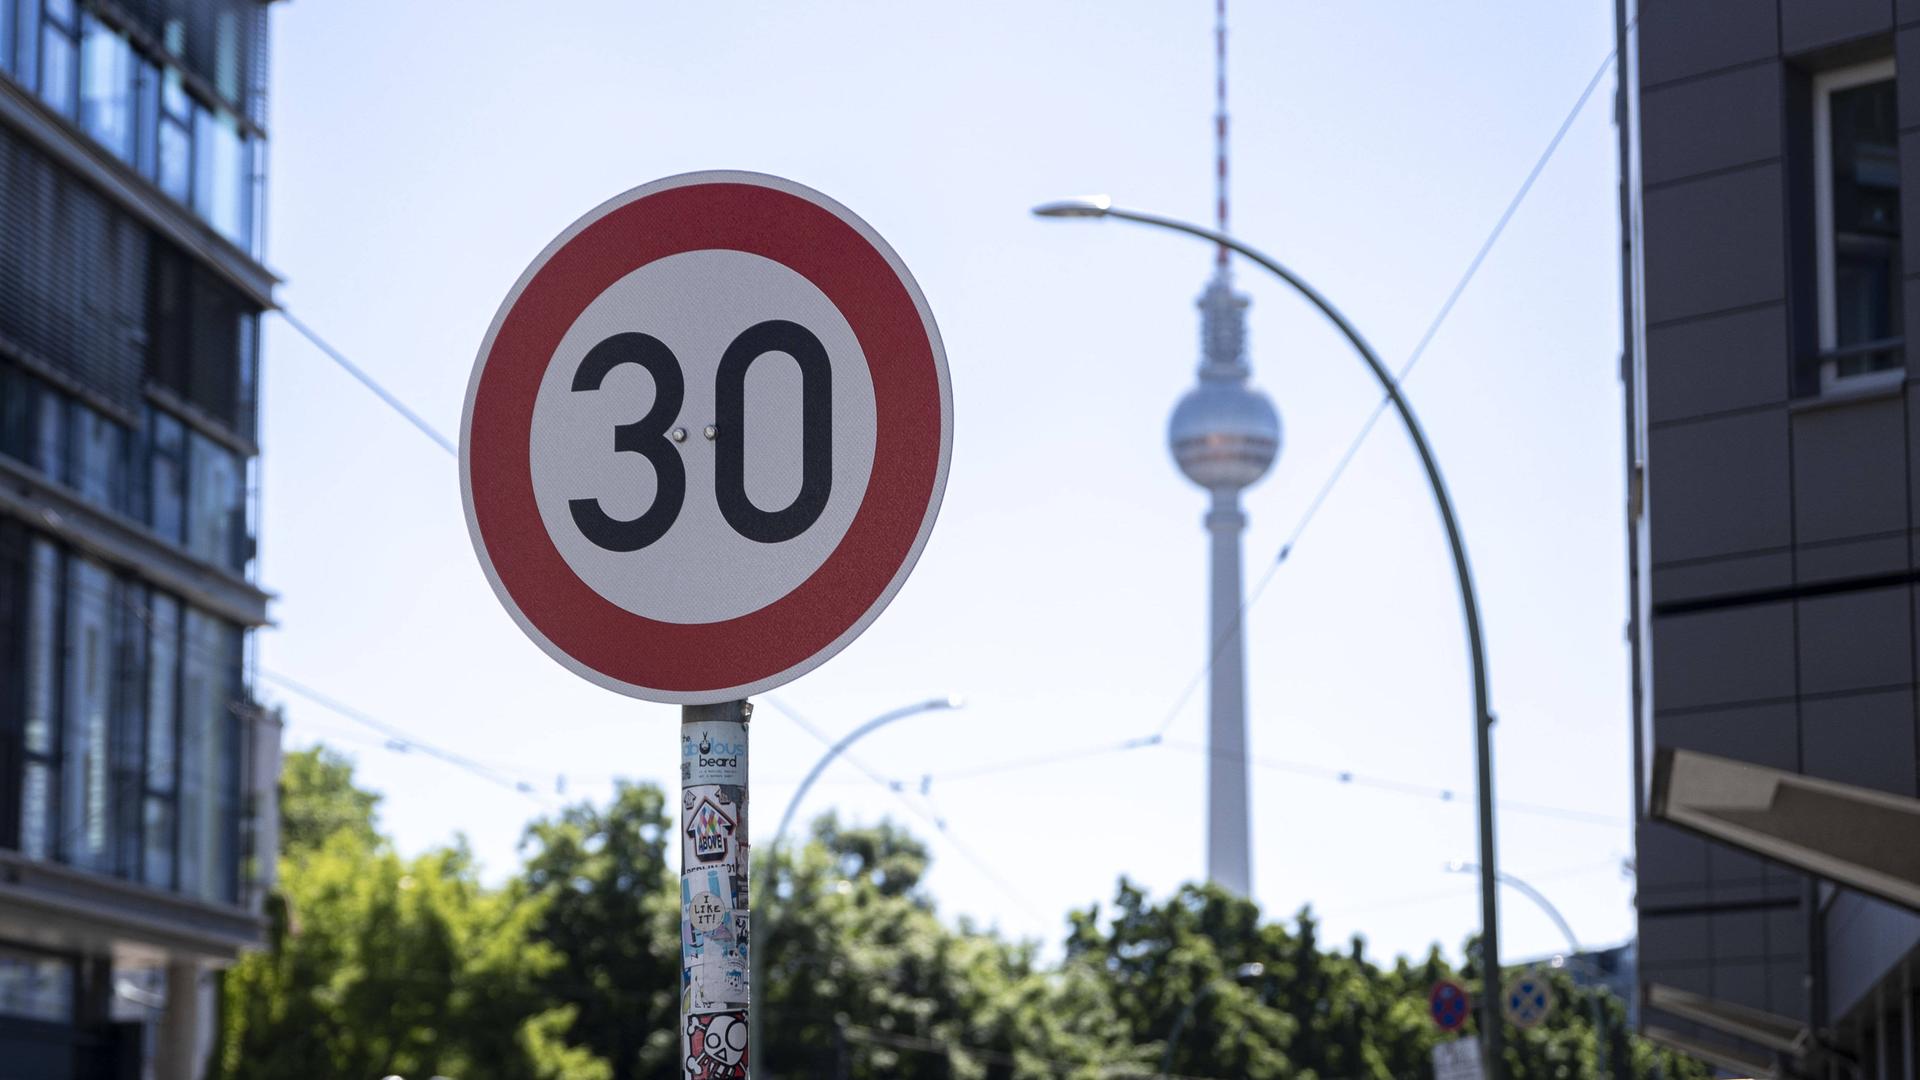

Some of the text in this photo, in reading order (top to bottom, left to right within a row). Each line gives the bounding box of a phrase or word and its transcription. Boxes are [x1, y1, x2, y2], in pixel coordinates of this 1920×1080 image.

[568, 319, 832, 552] 30
[683, 736, 744, 757] abulous
[699, 754, 737, 768] beard
[698, 834, 723, 852] ABOVE
[704, 895, 709, 903] I
[694, 904, 721, 914] LIKE
[698, 914, 716, 924] IT!
